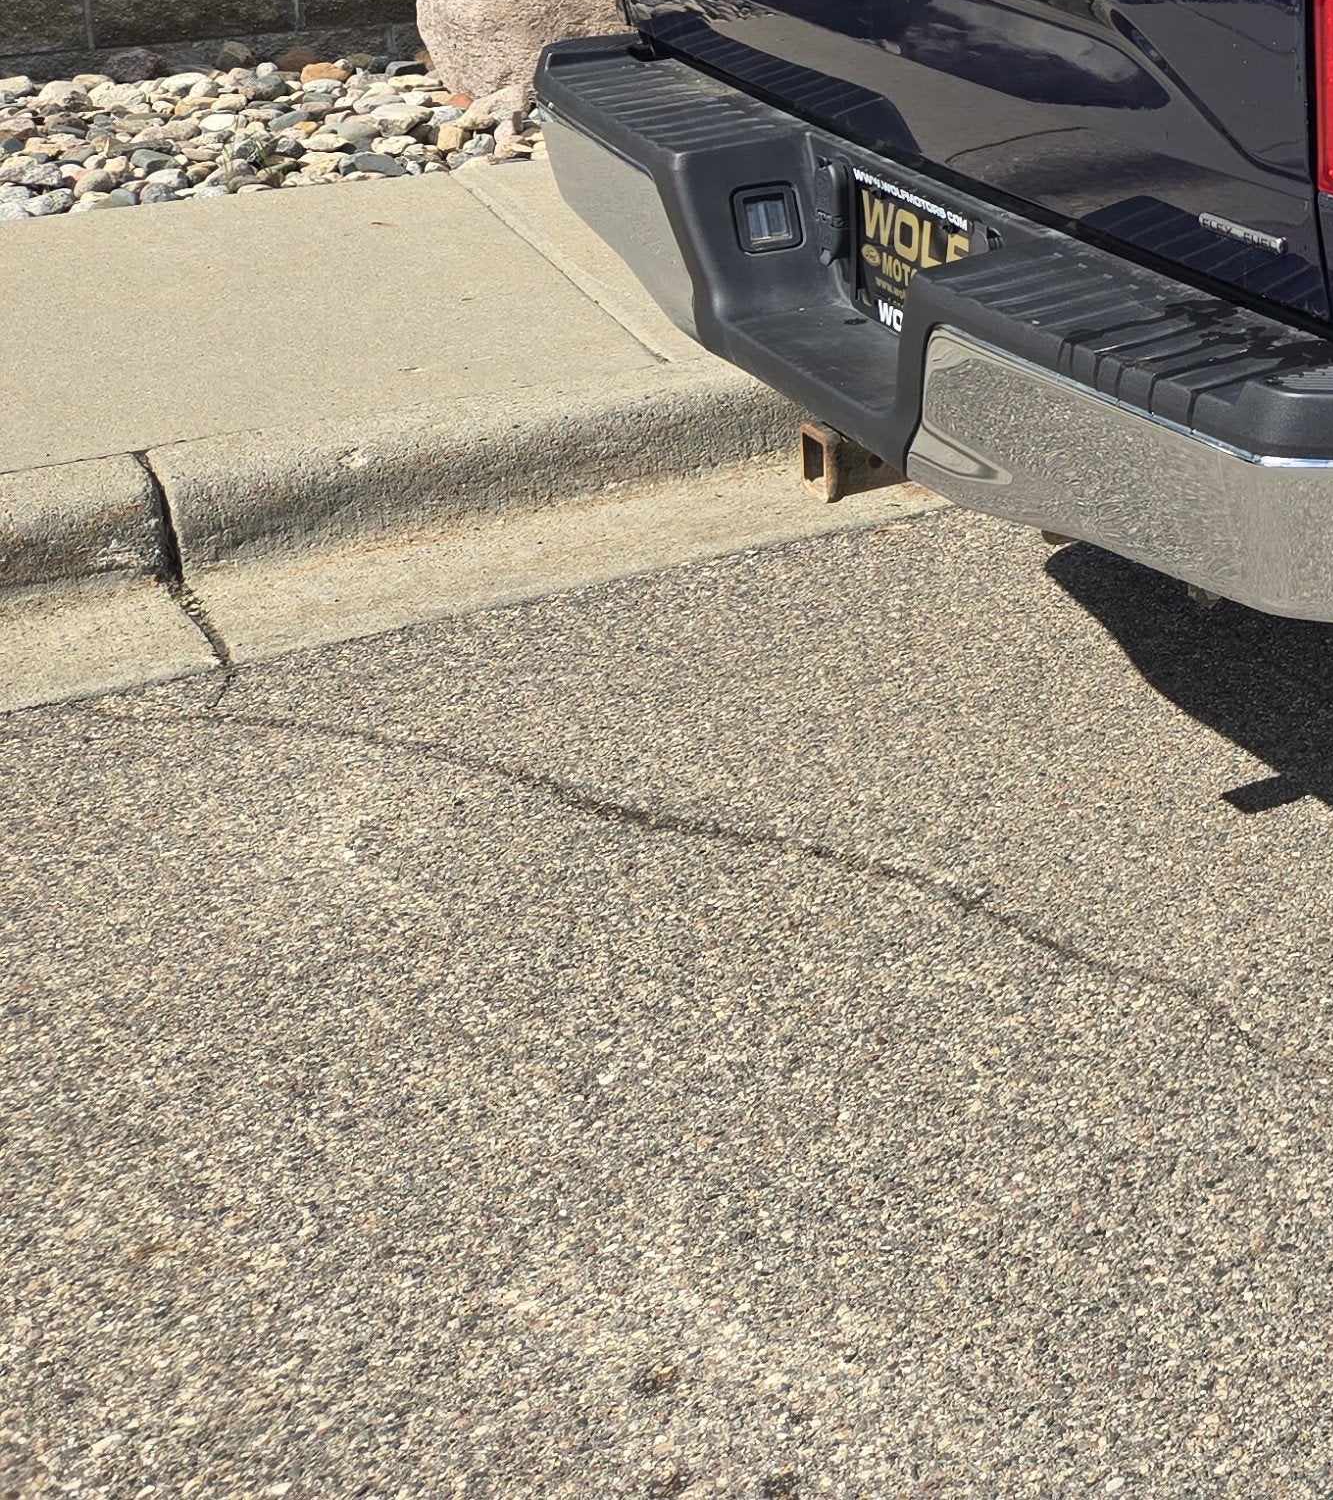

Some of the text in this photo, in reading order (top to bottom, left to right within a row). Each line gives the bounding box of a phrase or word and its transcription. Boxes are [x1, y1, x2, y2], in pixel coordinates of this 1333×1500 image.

[861, 189, 970, 269] WOLF
[1201, 217, 1280, 254] FLEX FUEL
